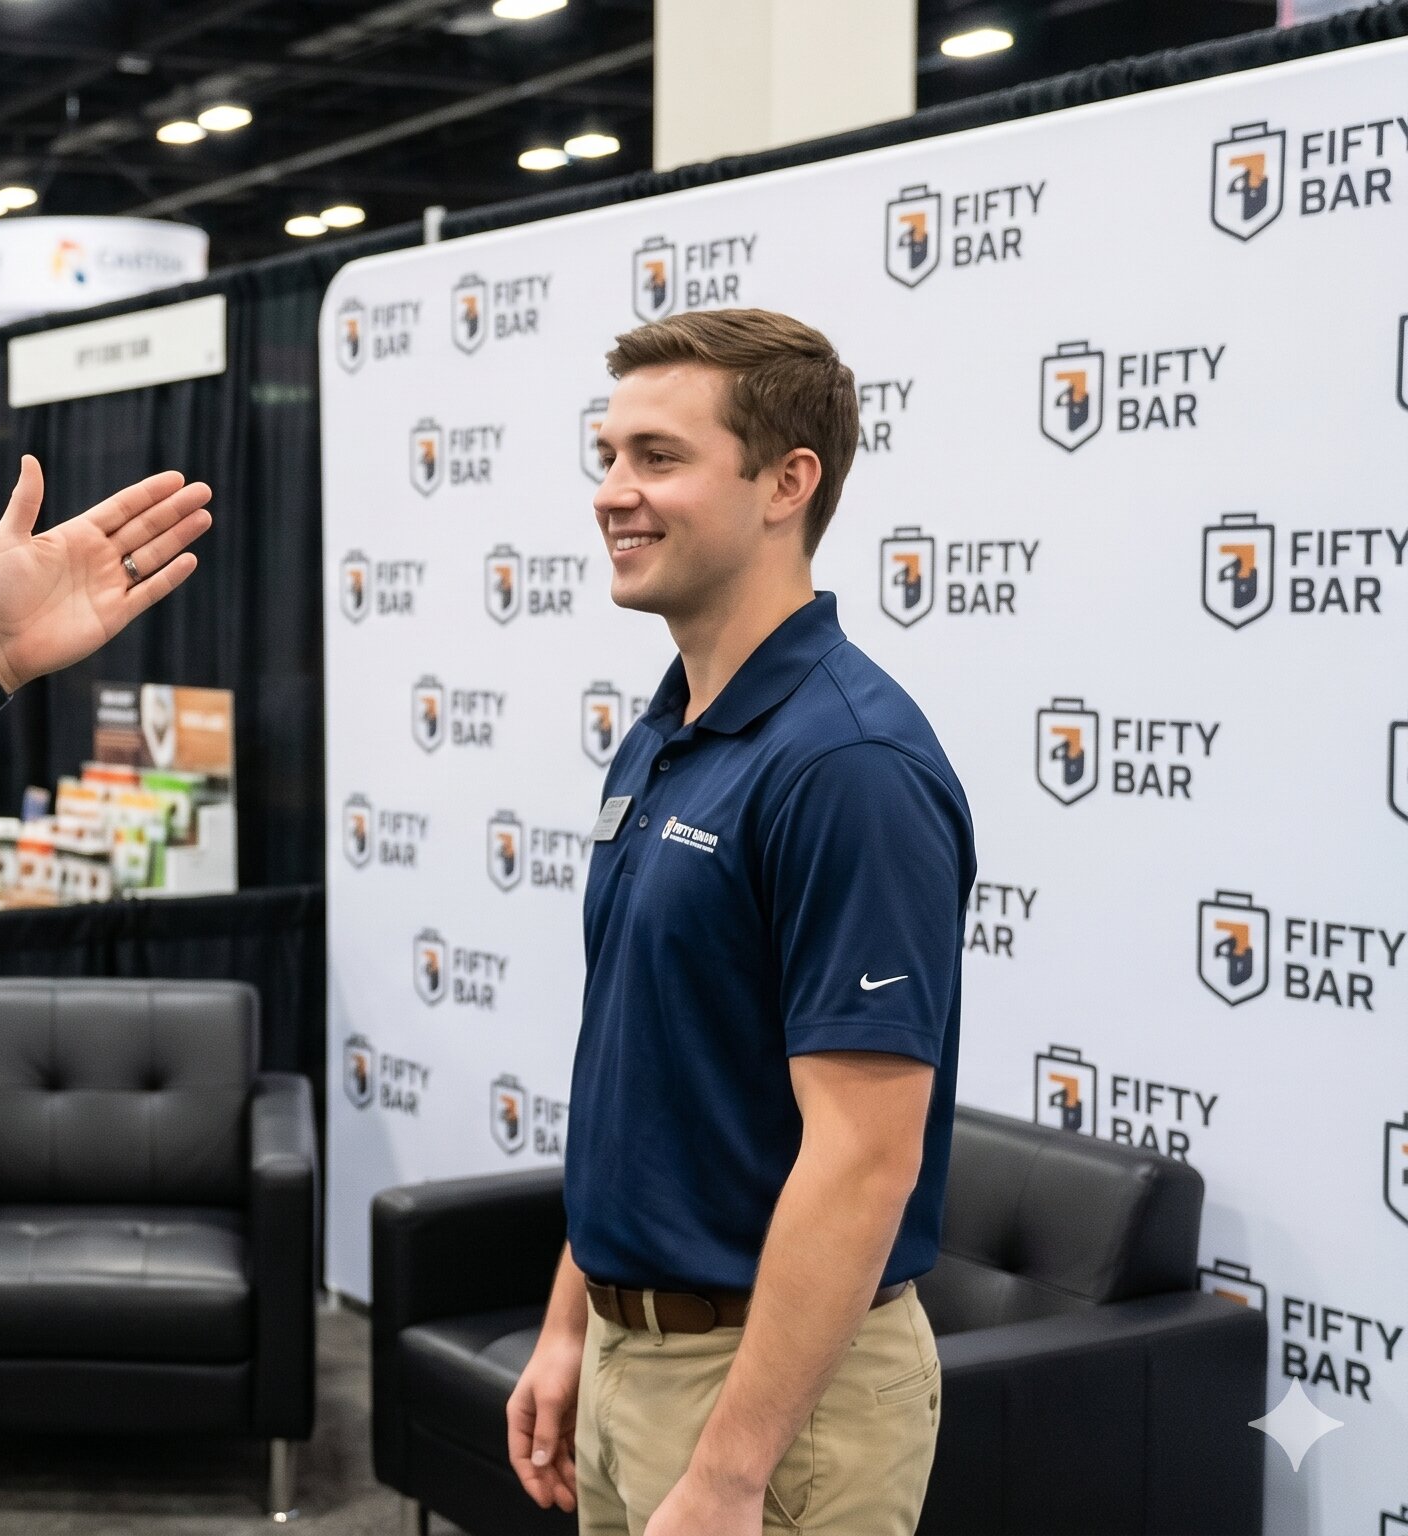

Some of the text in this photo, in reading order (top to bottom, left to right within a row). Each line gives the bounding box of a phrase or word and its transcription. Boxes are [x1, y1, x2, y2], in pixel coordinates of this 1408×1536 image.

[953, 181, 1046, 226] FIFTY
[1301, 168, 1391, 215] BAR
[685, 232, 758, 272] FIFTY
[953, 228, 1022, 267] BAR
[493, 274, 552, 303] FIFTY
[686, 274, 740, 307] BAR
[371, 300, 422, 327] FIFTY
[494, 308, 539, 340] BAR
[374, 331, 411, 360] BAR
[1118, 345, 1225, 389] FIFTY
[859, 380, 914, 413] FTY
[1118, 393, 1197, 432] BAR
[449, 425, 505, 452] FIFTY
[858, 421, 892, 453] AR
[450, 457, 492, 485] BAR
[947, 540, 1039, 574] FIFTY
[1291, 528, 1408, 567] FIFTY
[376, 560, 425, 585] FIFTY
[527, 555, 588, 583] FIFTY
[376, 590, 413, 616] BAR
[528, 589, 573, 616] BAR
[947, 582, 1016, 615] BAR
[1290, 576, 1381, 614] BAR
[451, 688, 506, 717] FIFTY
[452, 720, 493, 748] BAR
[1113, 718, 1220, 757] FIFTY
[1113, 760, 1191, 799] BAR
[378, 810, 429, 839] FIFTY
[379, 842, 417, 867] BAR
[530, 827, 592, 860] FIFTY
[531, 860, 575, 891] BAR
[967, 884, 1037, 919] FTY
[963, 922, 1014, 957] AR
[1285, 917, 1407, 968] FIFTY
[453, 948, 508, 983] FIFTY
[453, 978, 496, 1010] BAR
[1285, 963, 1374, 1011] BAR
[379, 1054, 431, 1089] FIFTY
[379, 1084, 419, 1116] BAR
[1111, 1075, 1218, 1126] FIFTY
[1280, 1294, 1404, 1361] FIFTY
[1281, 1340, 1372, 1403] BAR
